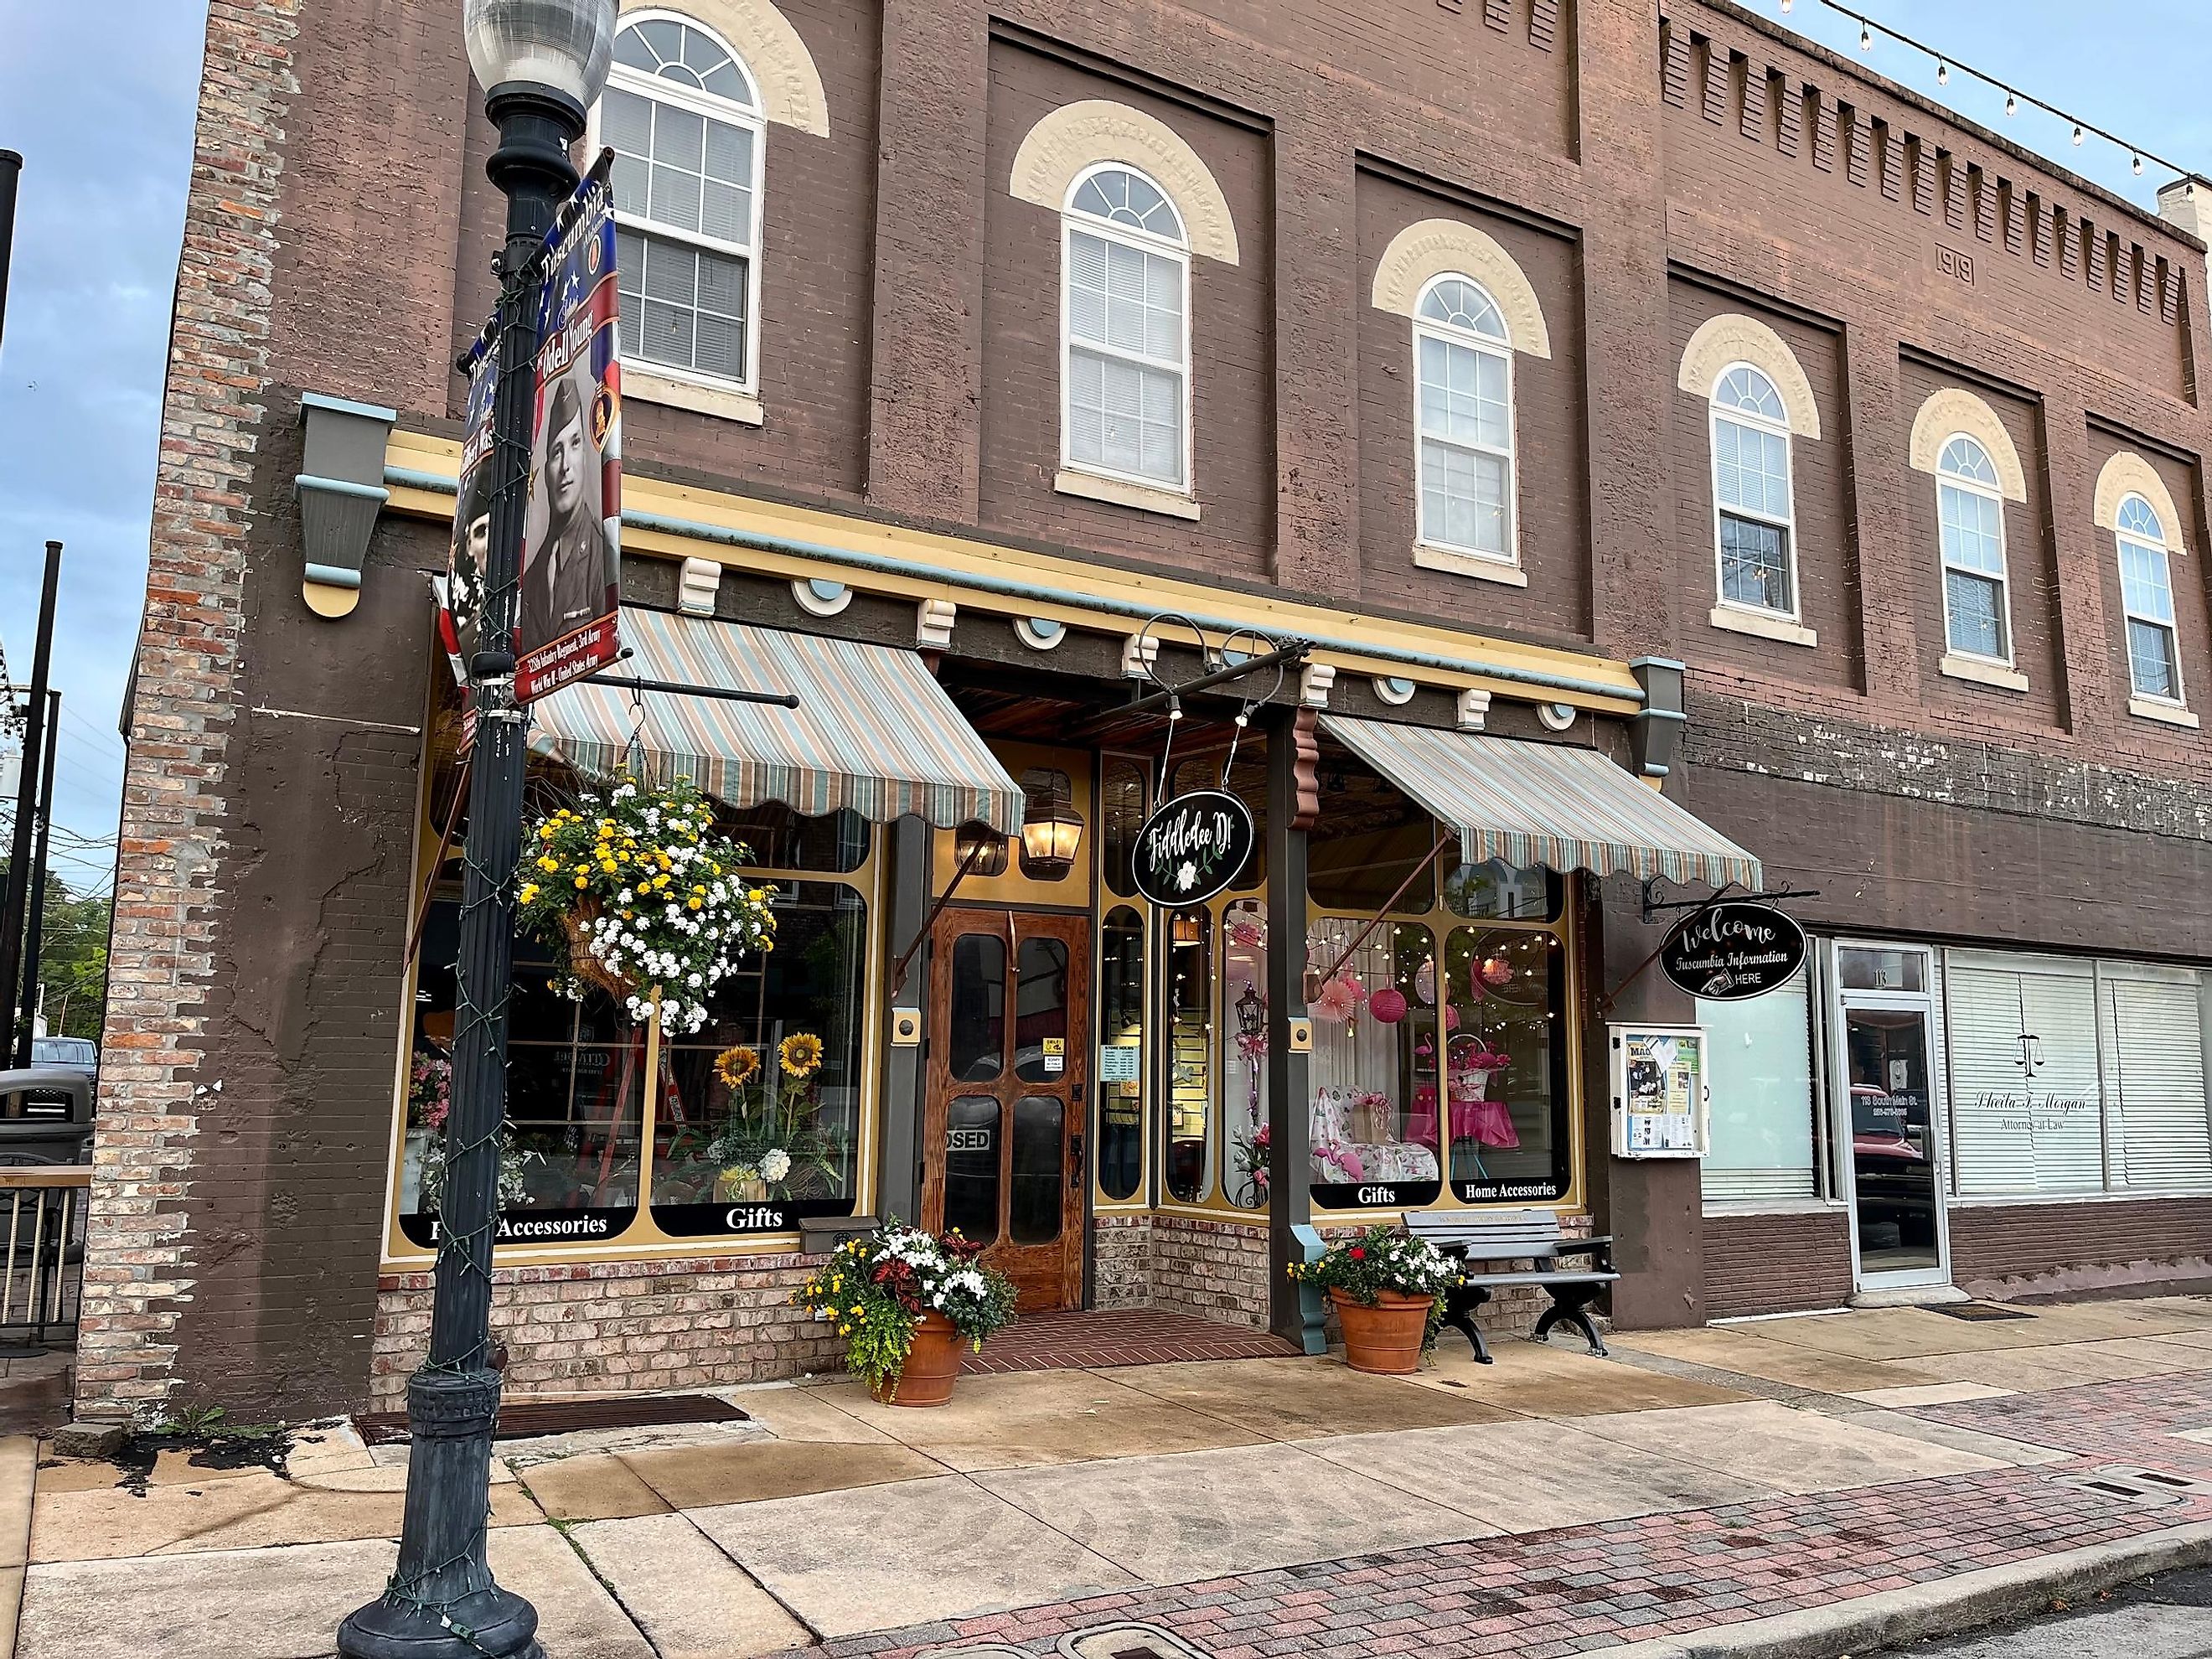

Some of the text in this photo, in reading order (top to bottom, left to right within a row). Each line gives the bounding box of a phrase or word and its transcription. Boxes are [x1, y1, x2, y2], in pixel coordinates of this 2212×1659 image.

[540, 185, 604, 286] Tuscumbia
[1936, 247, 1971, 283] 1919
[542, 309, 594, 380] Odell Young
[588, 629, 601, 643] Army
[587, 654, 598, 669] Army
[1149, 808, 1212, 872] Fiddledee
[1682, 907, 1776, 953] Welcome
[1676, 949, 1789, 971] Tuscumbia Information
[1735, 972, 1763, 985] HERE
[2038, 1092, 2086, 1117] Morgan
[1357, 1187, 1396, 1204] Gifts
[1465, 1184, 1557, 1199] Home Accessories
[495, 1215, 607, 1237] Accessories
[726, 1208, 783, 1229] Gifts
